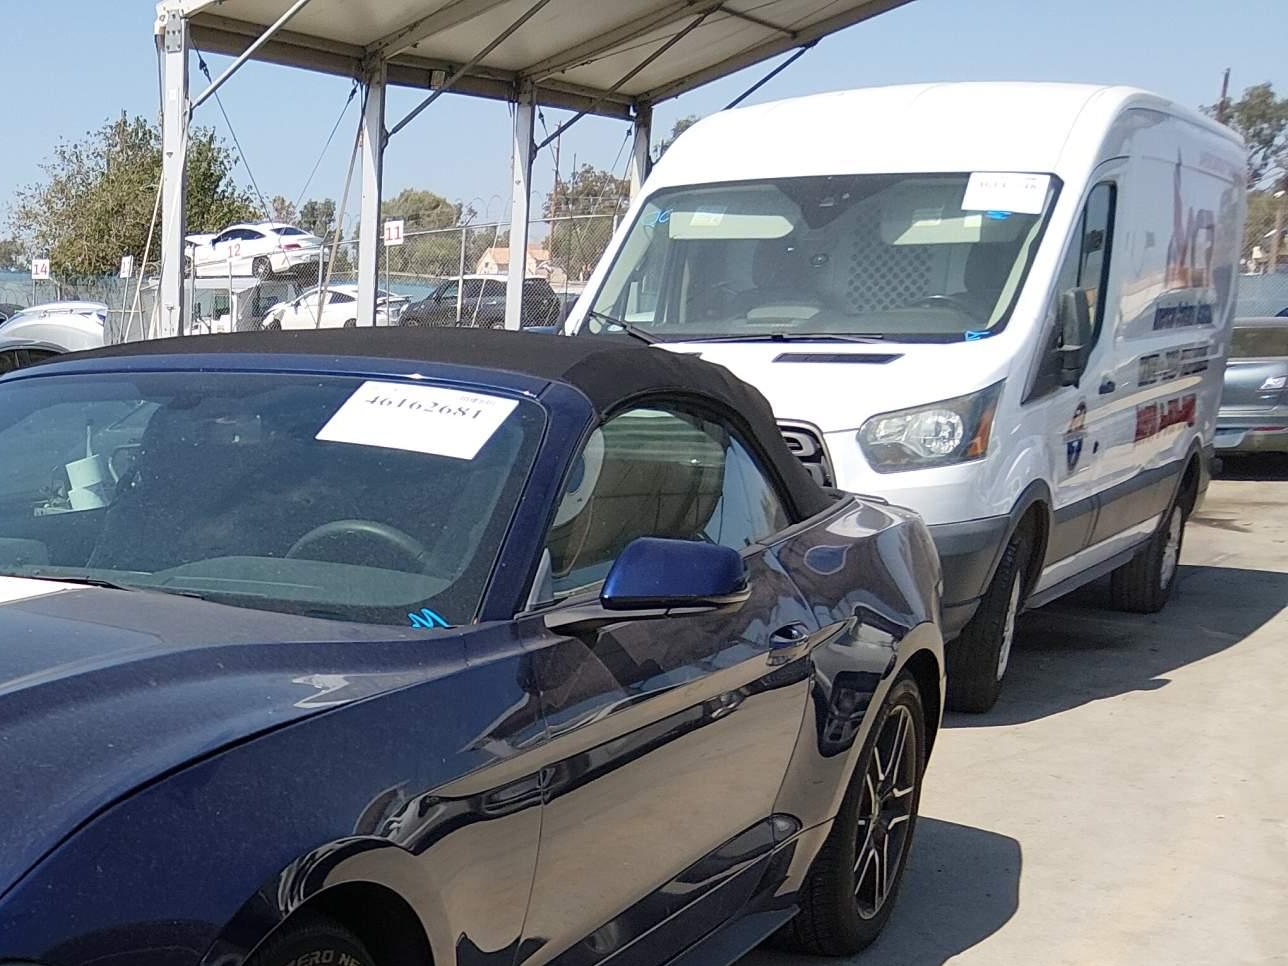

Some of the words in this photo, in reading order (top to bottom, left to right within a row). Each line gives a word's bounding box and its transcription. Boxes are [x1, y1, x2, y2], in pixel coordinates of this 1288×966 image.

[386, 225, 402, 241] 11
[228, 243, 241, 258] 12
[33, 263, 48, 275] 14
